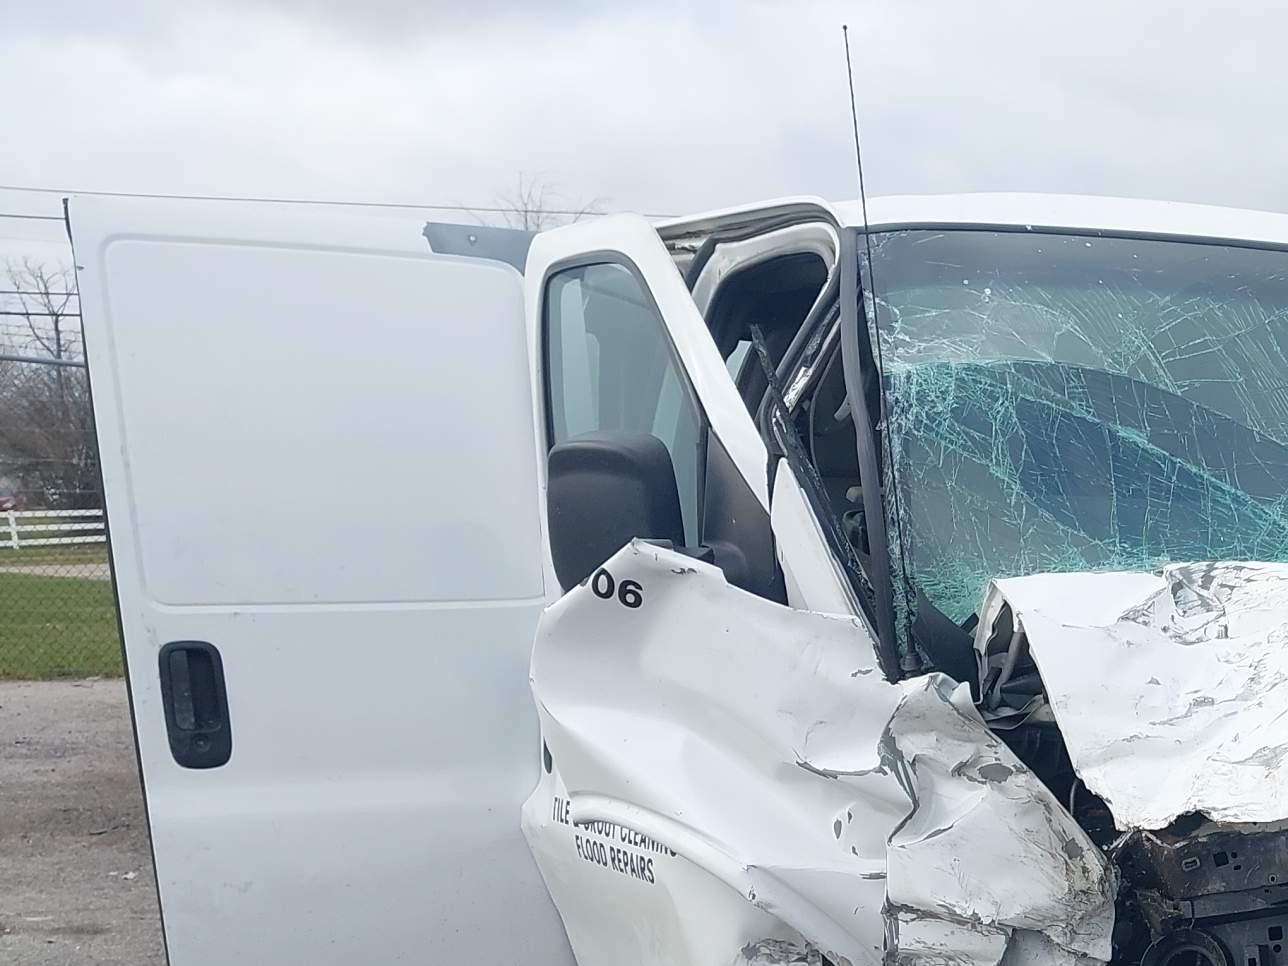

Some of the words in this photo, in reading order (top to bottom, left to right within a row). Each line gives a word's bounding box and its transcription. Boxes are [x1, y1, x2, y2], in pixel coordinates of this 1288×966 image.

[592, 567, 643, 609] 06
[553, 797, 570, 825] TILE
[575, 835, 608, 867] FLOOD
[610, 846, 655, 884] REPAIRS
